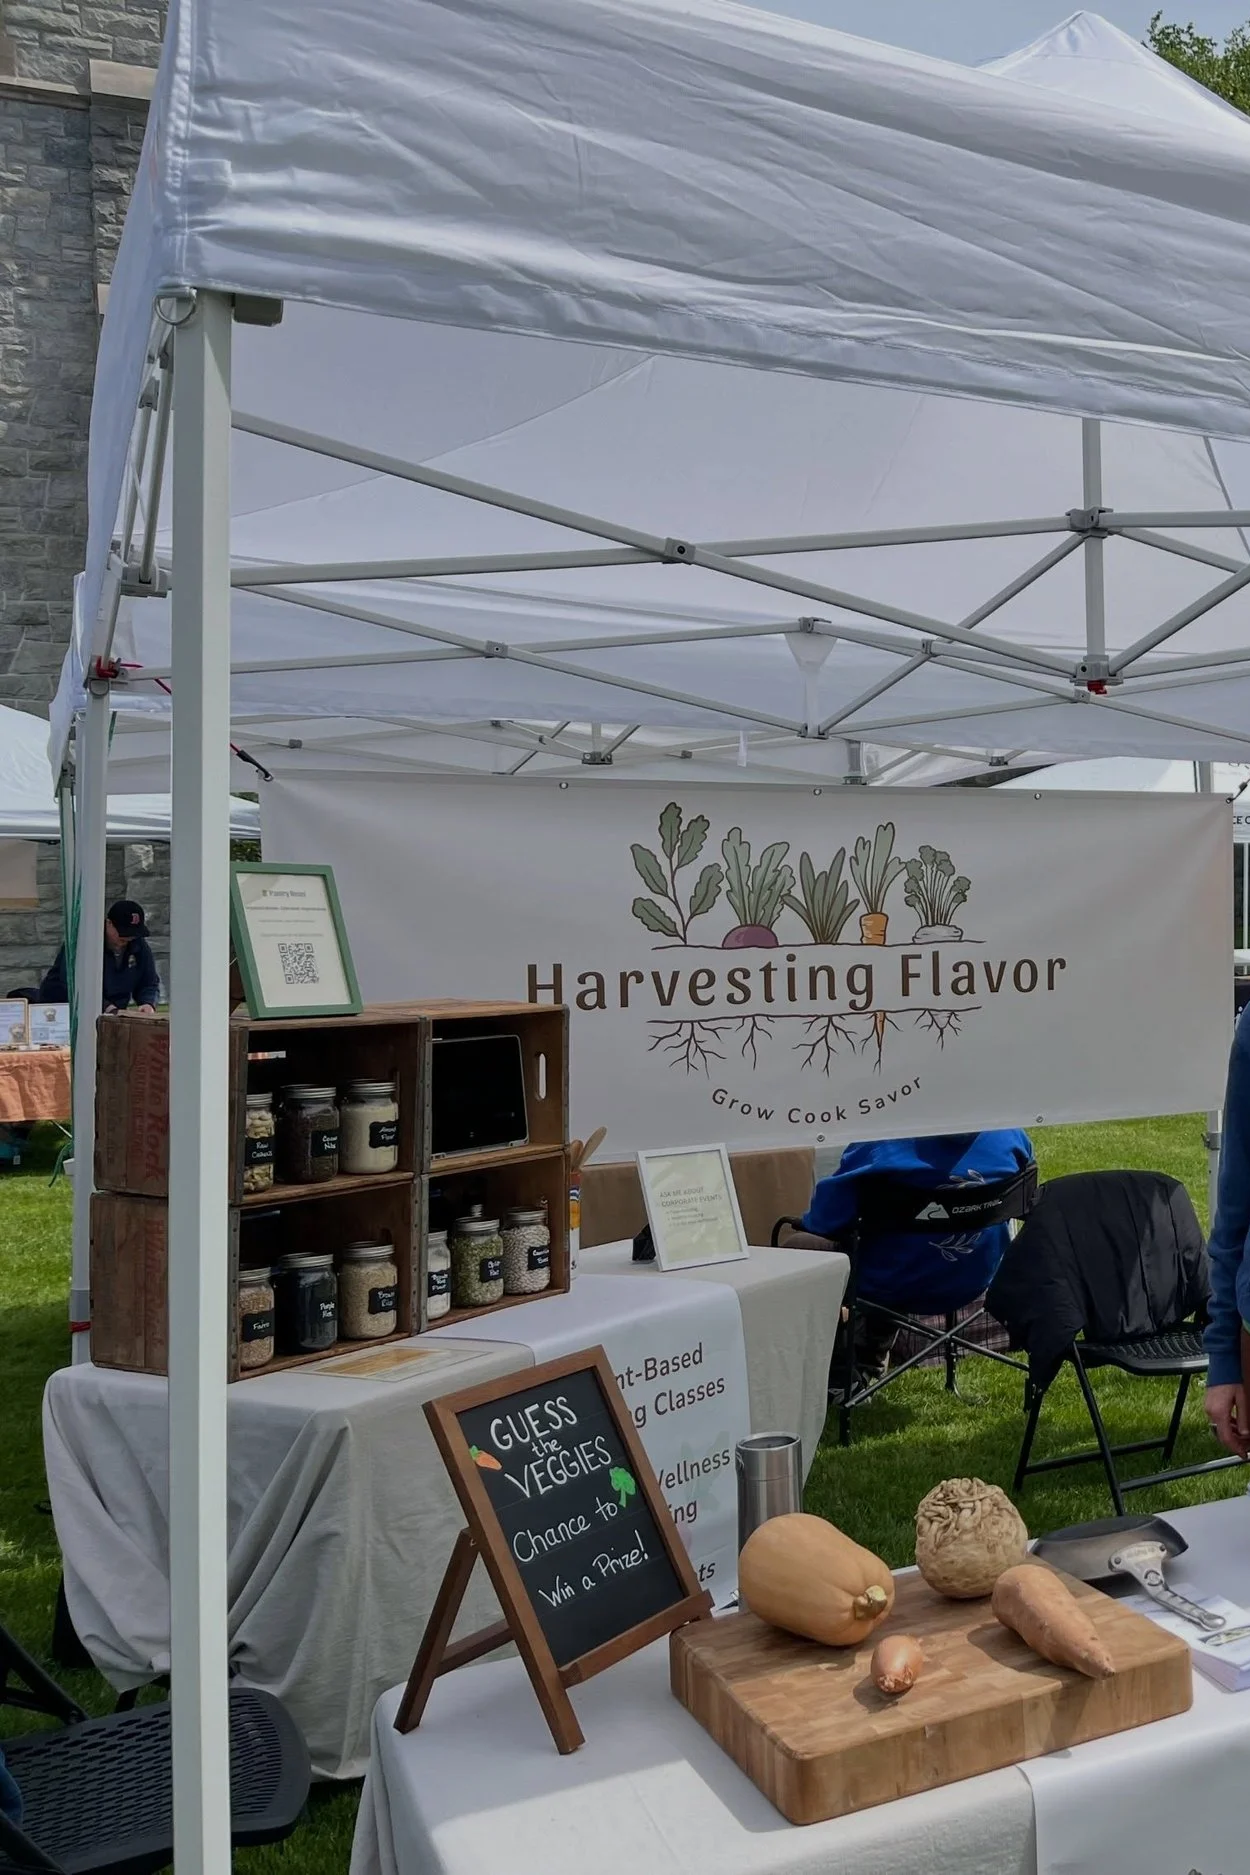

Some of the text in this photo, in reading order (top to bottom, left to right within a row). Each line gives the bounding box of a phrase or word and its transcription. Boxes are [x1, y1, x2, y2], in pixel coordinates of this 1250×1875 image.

[526, 950, 1067, 1011] Harvesting Flavor
[711, 1077, 924, 1124] Grow Cook Savor
[615, 1342, 704, 1391] nt-Based
[489, 1396, 578, 1451] GUESS
[654, 1376, 726, 1416] Classes
[504, 1435, 612, 1499] VEGGIES
[531, 1438, 562, 1458] the
[513, 1497, 618, 1563] Chance to
[538, 1530, 649, 1608] Win a Prize!
